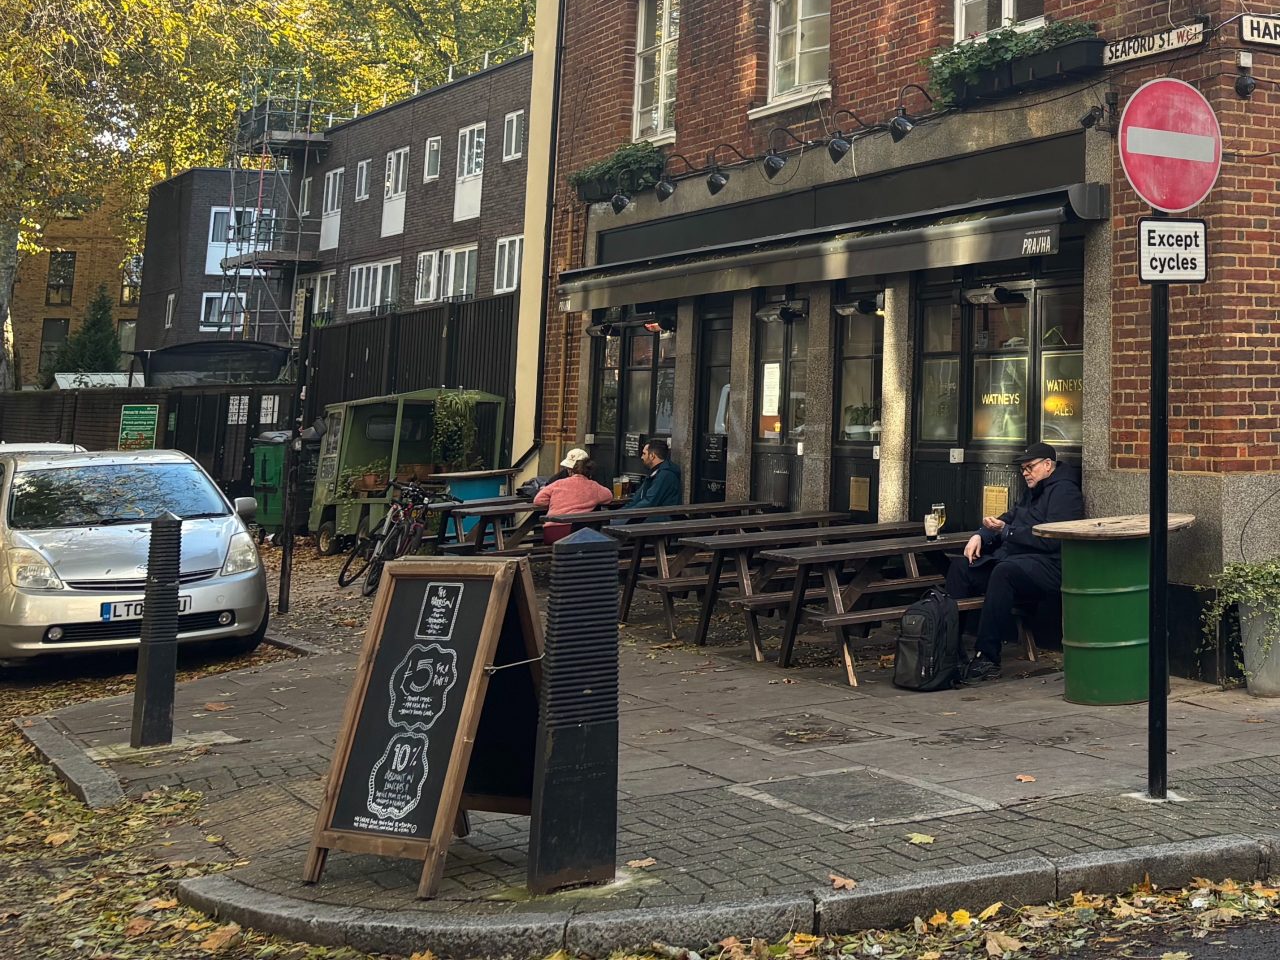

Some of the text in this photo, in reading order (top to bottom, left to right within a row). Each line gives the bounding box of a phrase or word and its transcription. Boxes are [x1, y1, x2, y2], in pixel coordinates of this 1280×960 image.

[1108, 36, 1155, 61] SEAFORD
[1159, 31, 1174, 49] ST.
[1147, 229, 1200, 251] Except
[1150, 252, 1197, 274] cycles
[1046, 378, 1083, 393] WATNEYS
[981, 392, 1020, 405] WATNEYS
[1054, 402, 1074, 416] ALES
[391, 743, 422, 772] 10%
